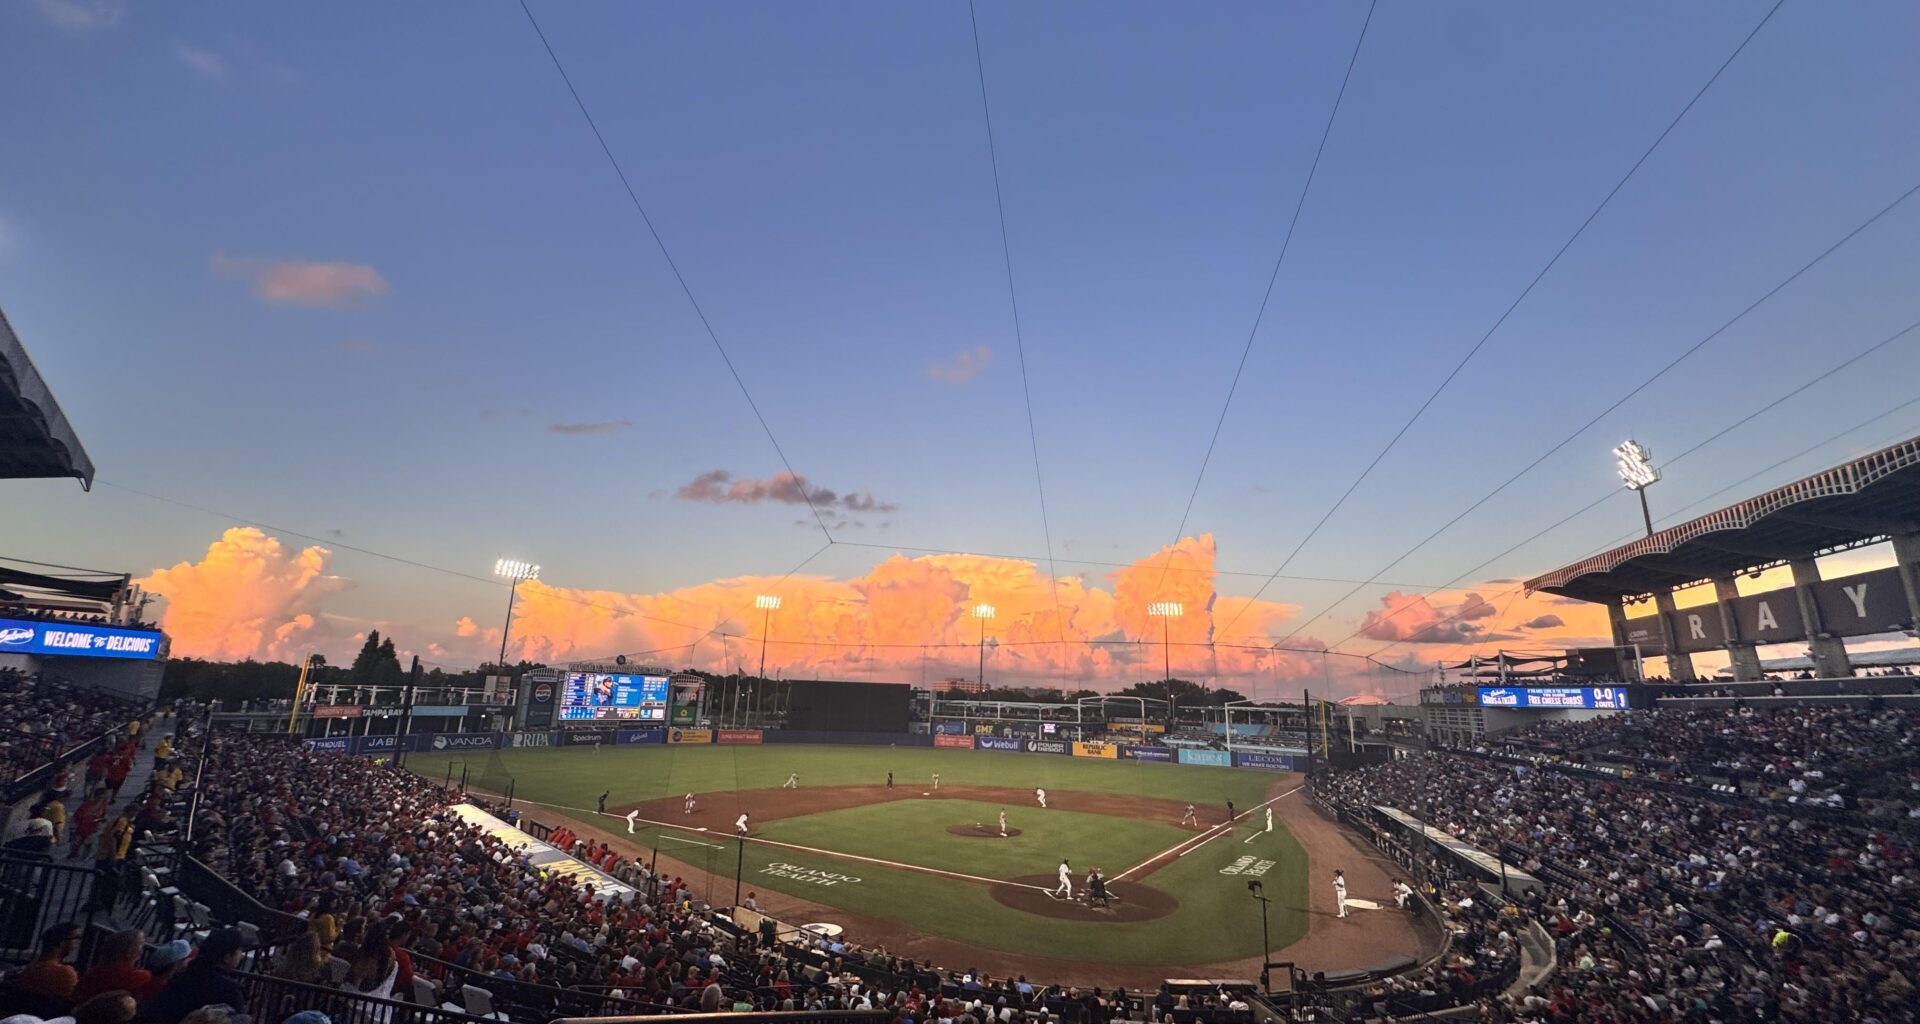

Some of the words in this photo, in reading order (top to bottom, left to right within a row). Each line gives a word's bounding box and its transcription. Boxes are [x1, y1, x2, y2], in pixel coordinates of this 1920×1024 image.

[44, 630, 94, 648] WELCOME
[106, 635, 151, 652] DELICIOUS
[1593, 688, 1612, 700] 0-0
[1528, 695, 1541, 705] FREE
[1541, 696, 1561, 705] CHEESE
[362, 709, 387, 717] TAMPA
[368, 738, 406, 747] JABI
[448, 736, 493, 746] VANDA
[523, 733, 549, 747] RIPA
[572, 734, 602, 742] Spectrum
[317, 740, 347, 749] FANDUEL
[993, 740, 1019, 750] Webull
[1082, 743, 1107, 751] REPUBLIC
[1248, 754, 1282, 764] LECOM
[759, 867, 838, 886] HEALTH
[768, 862, 862, 882] ORLANDO
